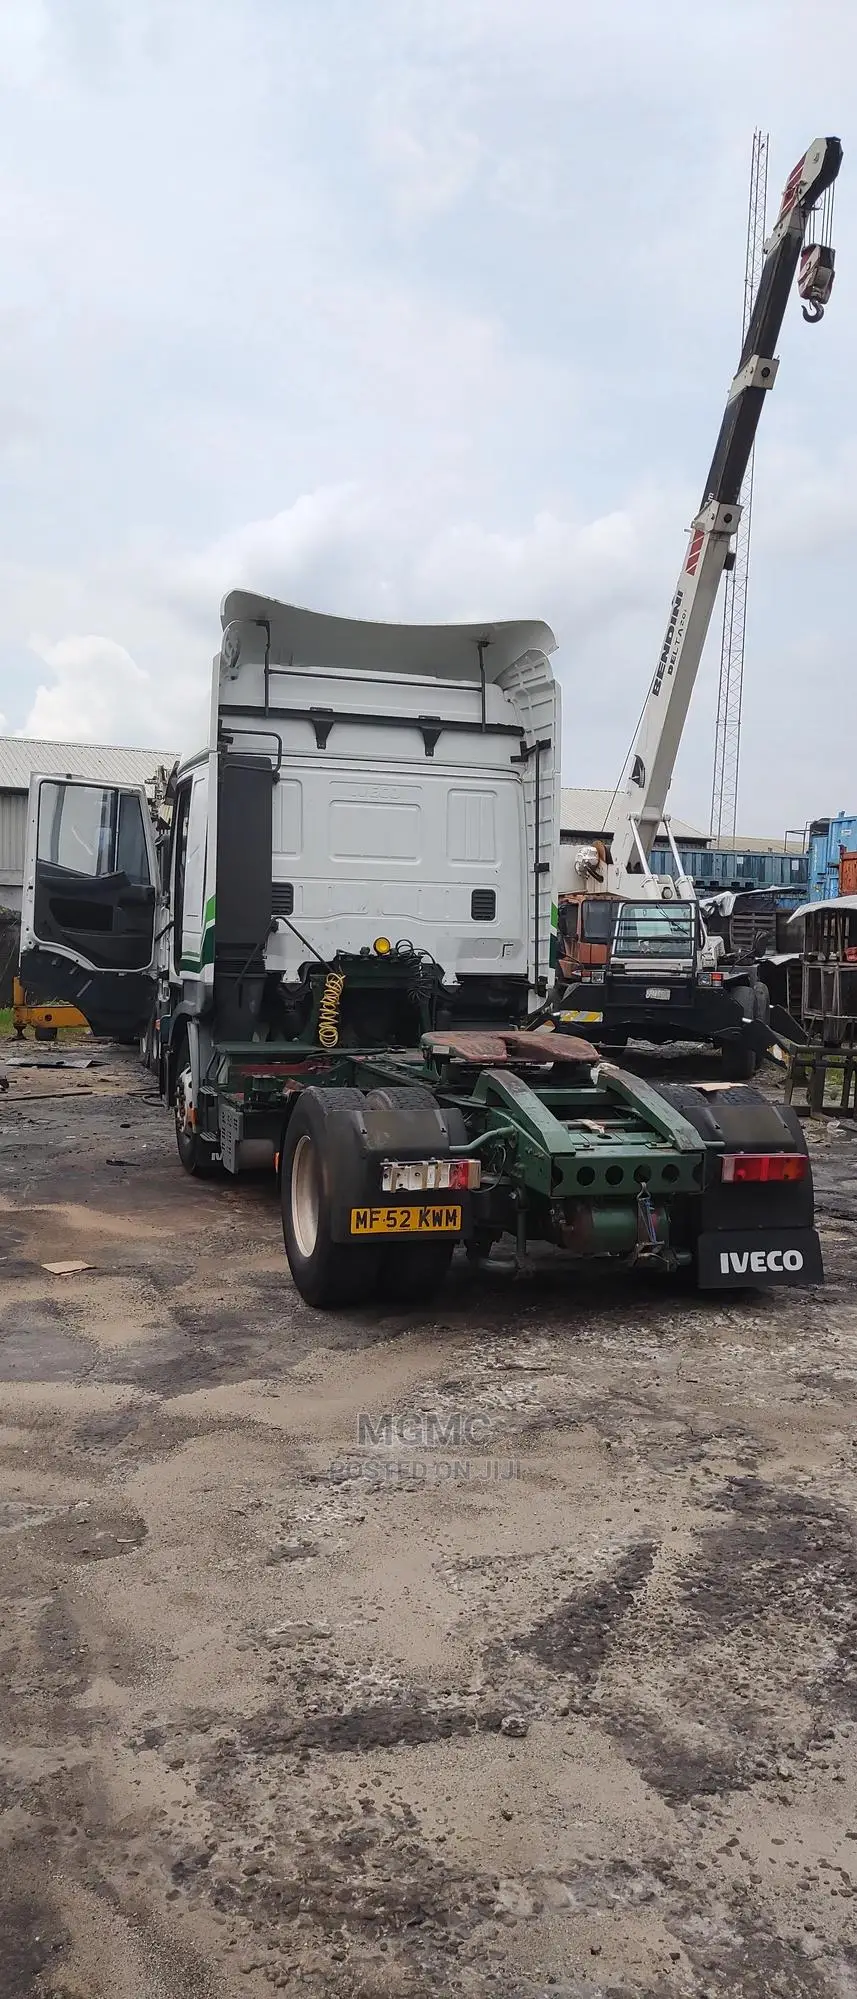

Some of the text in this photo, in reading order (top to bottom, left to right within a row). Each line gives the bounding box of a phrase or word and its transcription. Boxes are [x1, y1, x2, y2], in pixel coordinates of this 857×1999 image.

[652, 590, 684, 697] BENDINI
[667, 628, 684, 676] DELTA
[418, 1207, 457, 1228] KWM
[720, 1249, 804, 1274] IVECO
